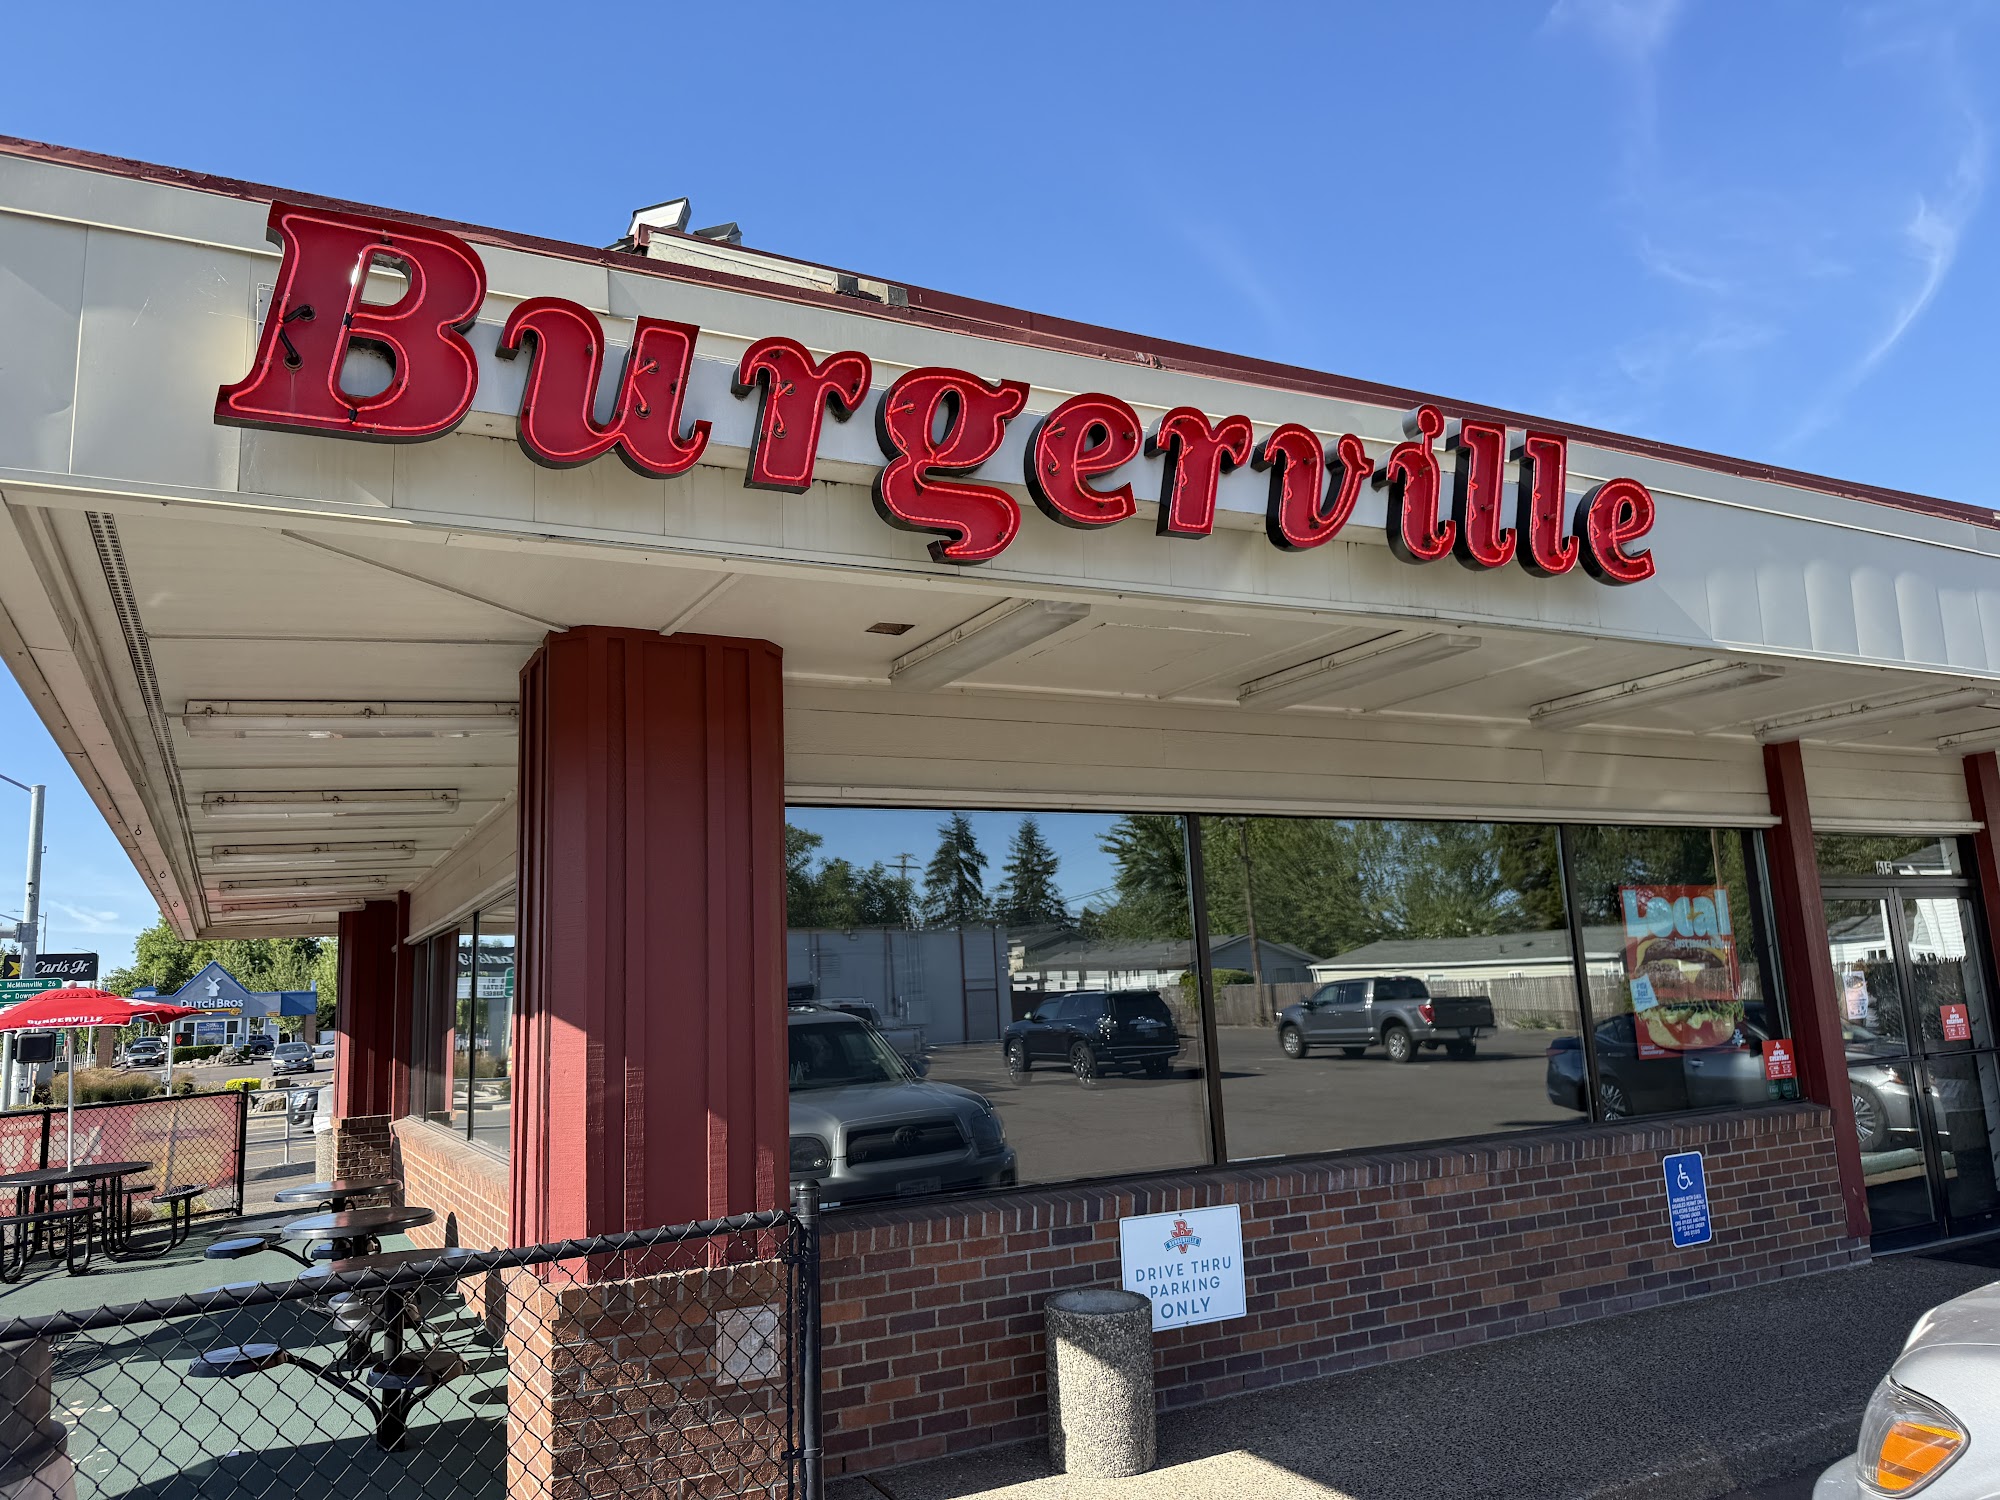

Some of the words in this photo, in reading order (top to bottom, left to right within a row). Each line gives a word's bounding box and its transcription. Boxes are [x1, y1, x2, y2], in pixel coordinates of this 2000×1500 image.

[214, 199, 1657, 586] Burgerville
[1622, 889, 1731, 937] Local
[35, 960, 70, 974] Carl's
[70, 960, 90, 974] Jr.
[216, 998, 244, 1008] BROS
[1135, 1263, 1184, 1282] DRIVE
[1191, 1256, 1231, 1274] THRU
[1150, 1276, 1220, 1298] PARKING
[1161, 1296, 1211, 1319] ONLY
